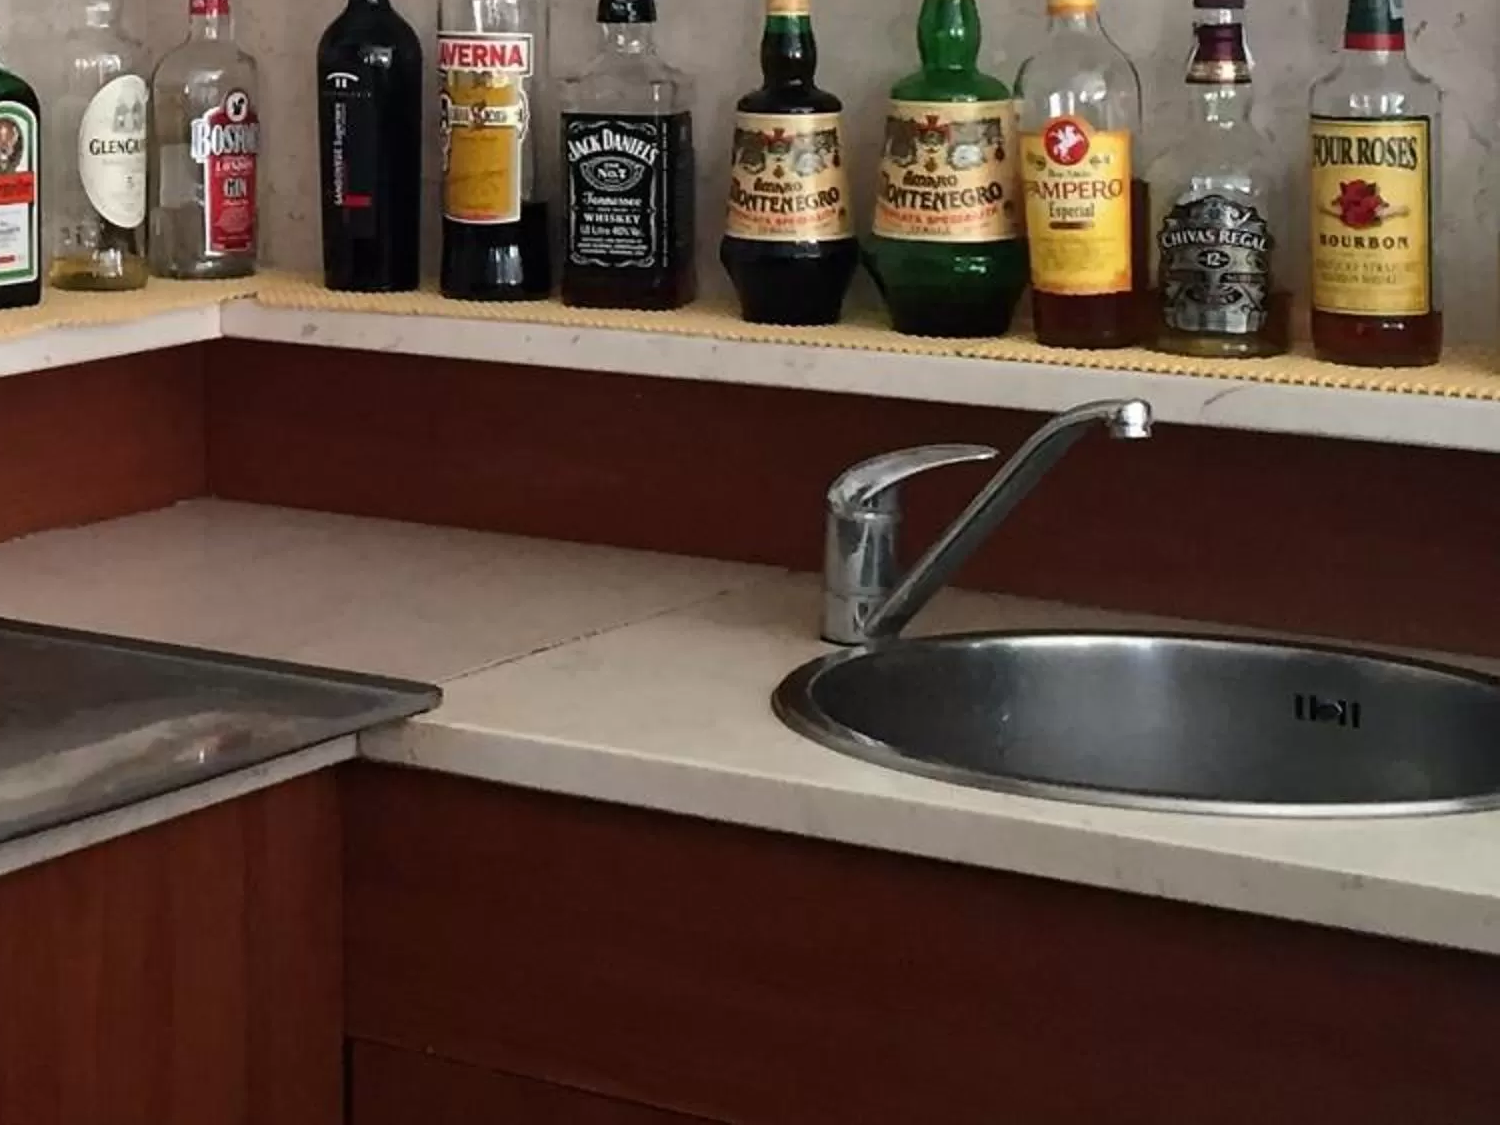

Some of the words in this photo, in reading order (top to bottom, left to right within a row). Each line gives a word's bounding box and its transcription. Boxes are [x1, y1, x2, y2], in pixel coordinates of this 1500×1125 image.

[568, 133, 603, 163] JACK
[602, 128, 660, 166] DANIEL'S
[1356, 135, 1418, 170] ROSES
[583, 212, 642, 225] WHISKEY
[1161, 229, 1217, 249] CHIVAS
[1319, 233, 1410, 250] BOURBON
[1206, 252, 1221, 266] 12
